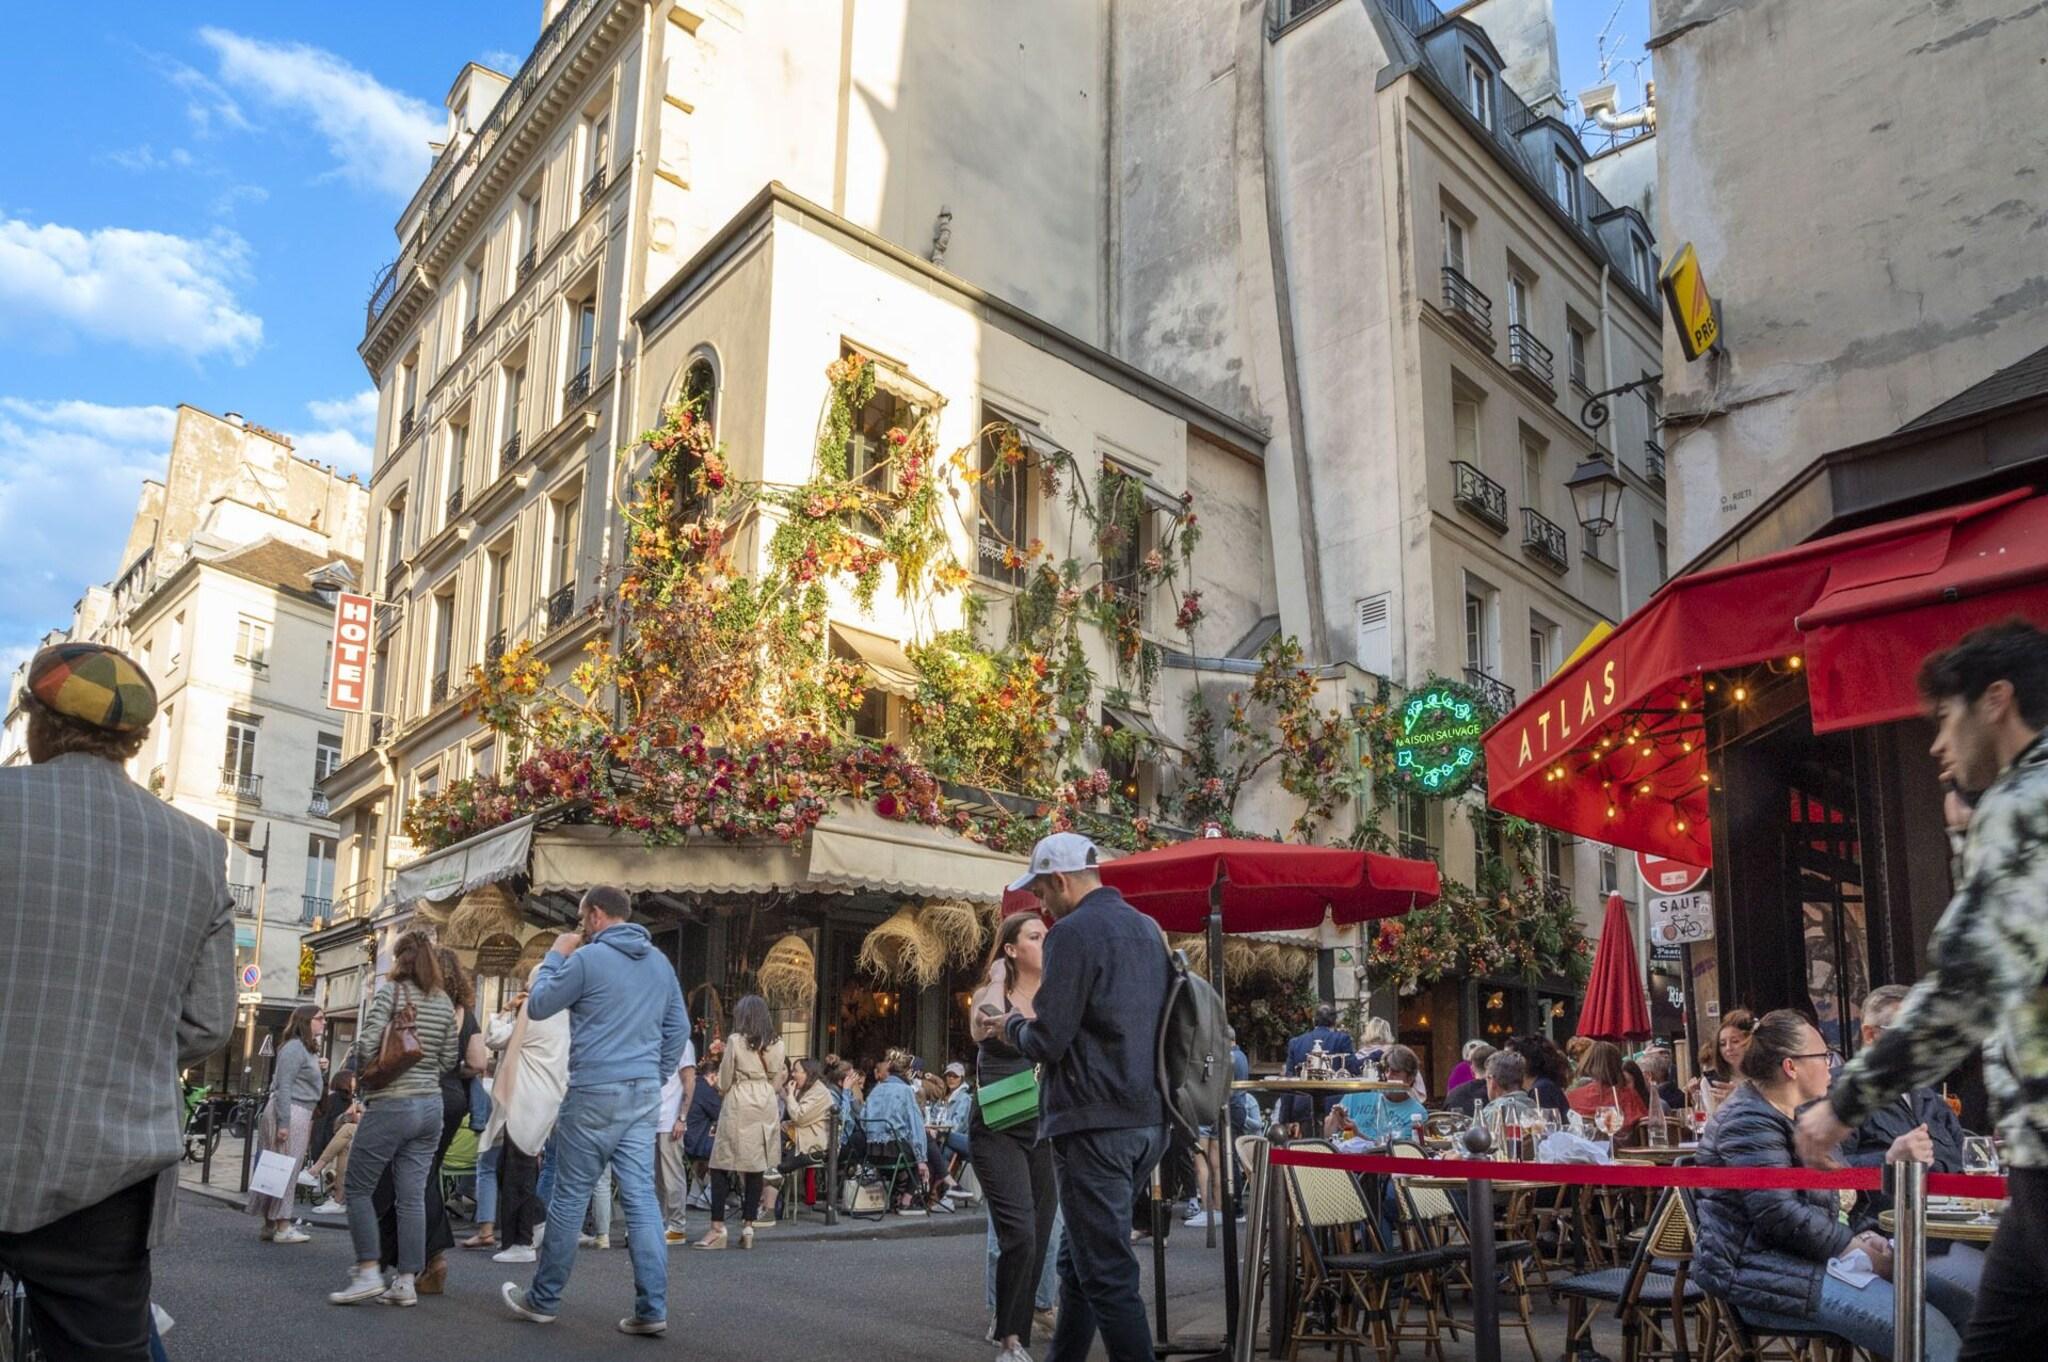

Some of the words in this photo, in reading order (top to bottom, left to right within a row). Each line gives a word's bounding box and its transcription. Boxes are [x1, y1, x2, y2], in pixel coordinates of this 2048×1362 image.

[337, 601, 368, 703] HOTEL
[1395, 733, 1435, 747] MAISON
[1435, 724, 1481, 740] SAUVAGE
[1518, 660, 1616, 768] ATLAS
[1659, 895, 1701, 913] SAUF
